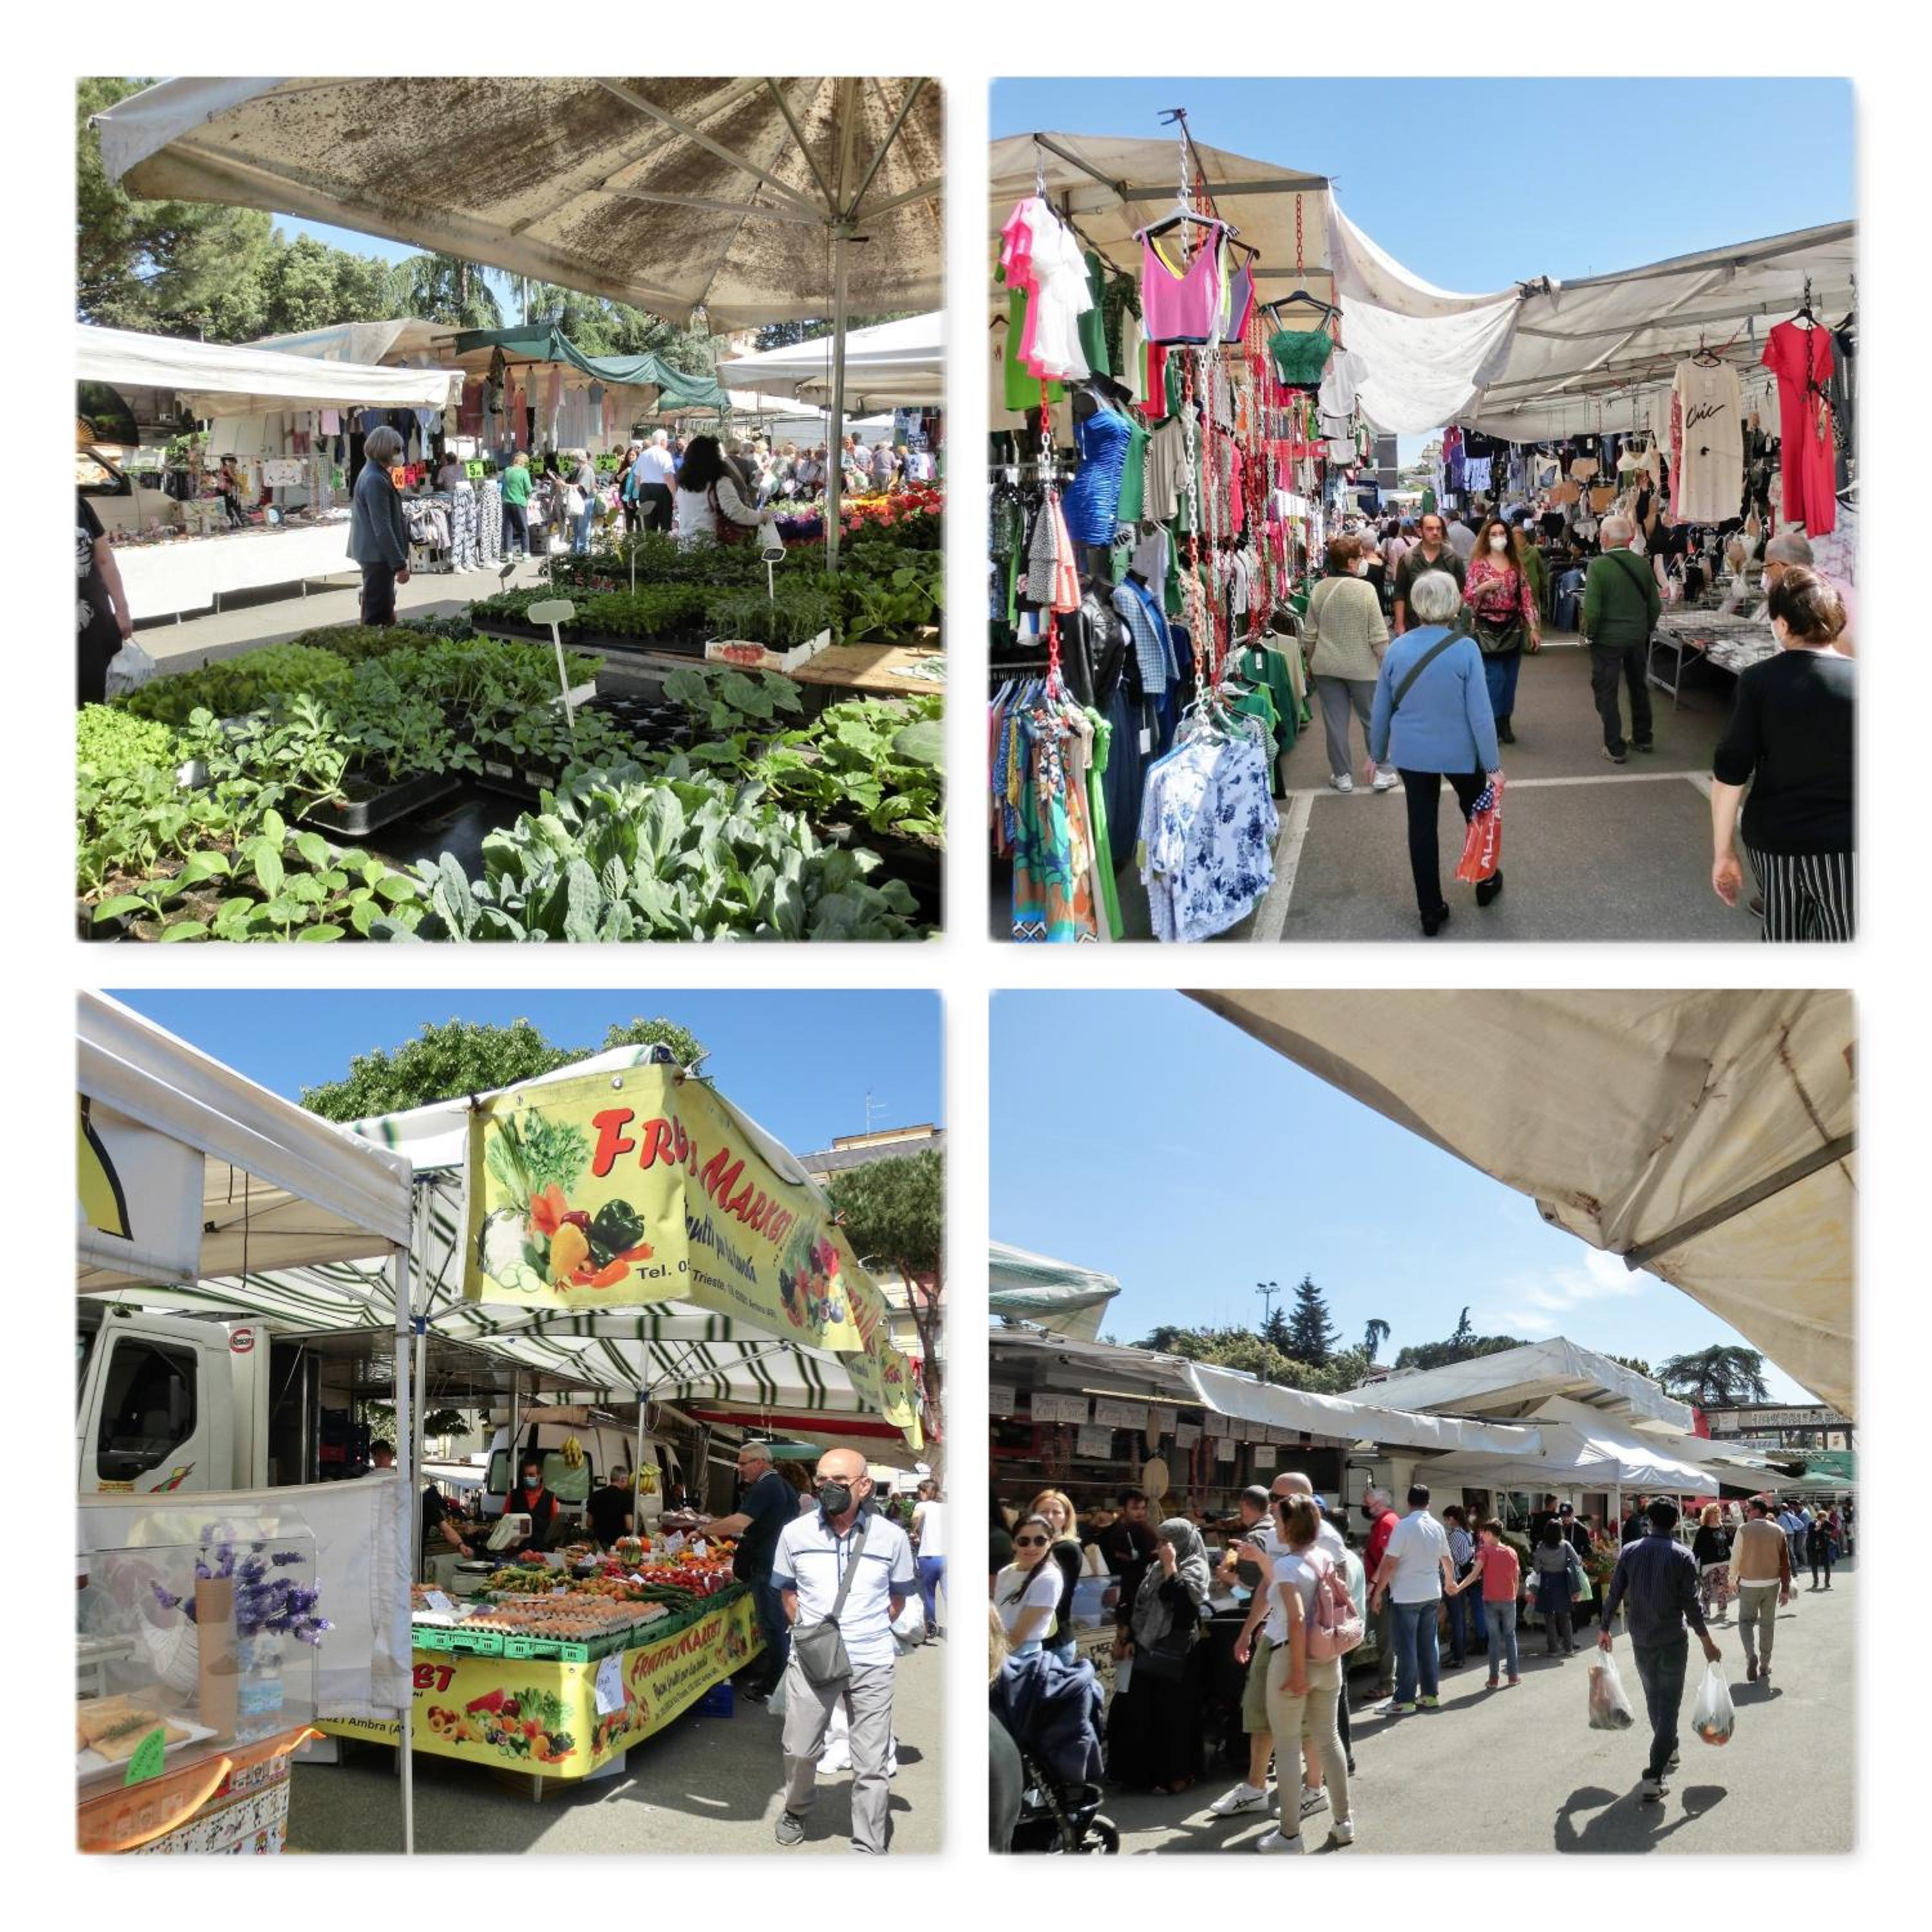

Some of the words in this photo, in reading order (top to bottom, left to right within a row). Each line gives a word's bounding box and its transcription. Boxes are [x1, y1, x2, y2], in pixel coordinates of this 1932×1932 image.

[1686, 402, 1725, 429] Chic
[636, 1264, 672, 1280] Tel.
[348, 1718, 386, 1732] Ambra
[390, 1725, 415, 1738] (A)
